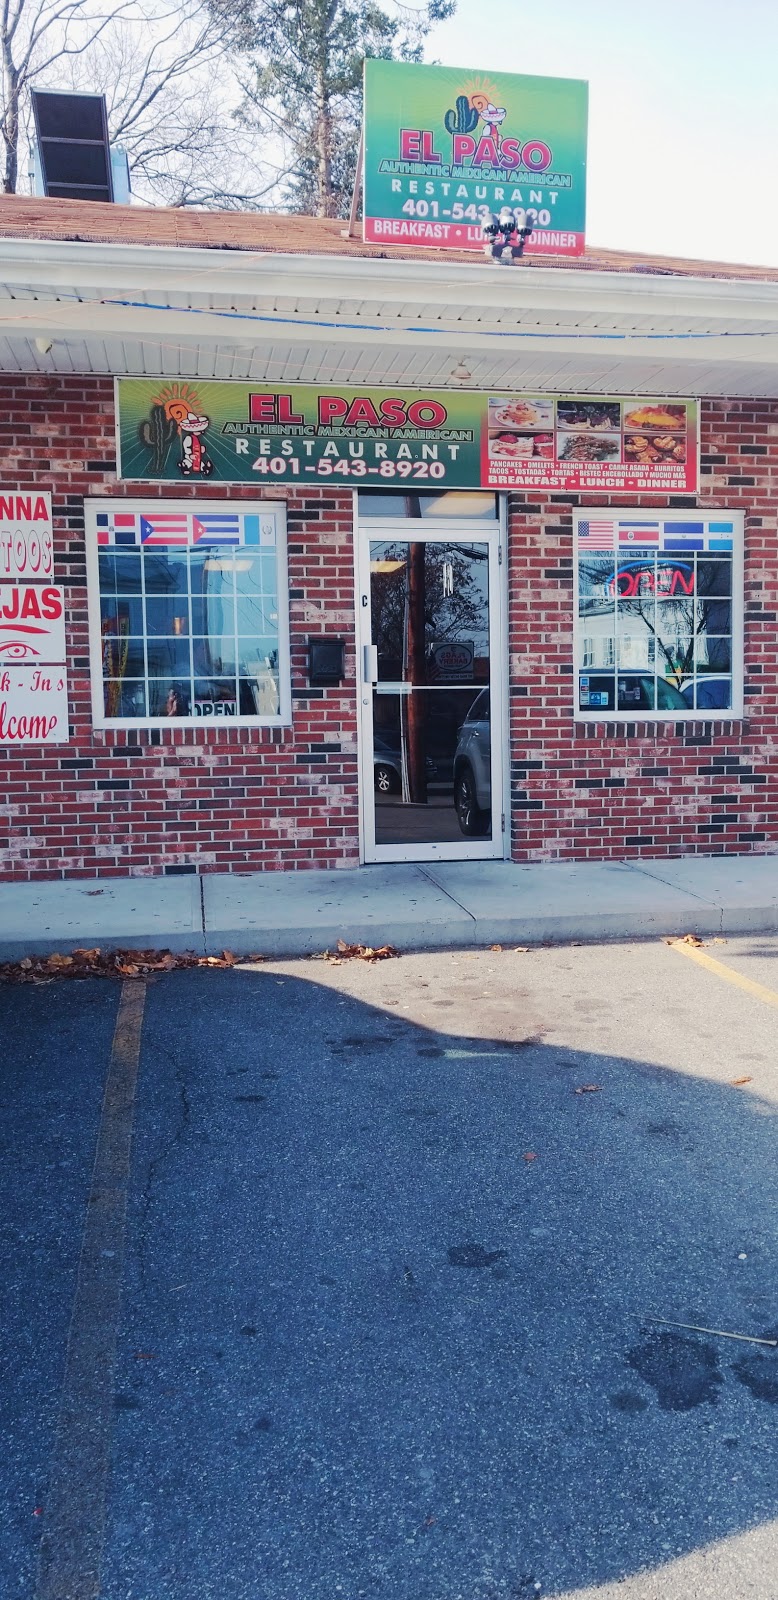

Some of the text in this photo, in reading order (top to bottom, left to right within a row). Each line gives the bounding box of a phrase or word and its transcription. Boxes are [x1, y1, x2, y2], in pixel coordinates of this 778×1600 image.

[400, 129, 552, 172] EL PASO
[380, 160, 571, 187] AUTHENTIC MEXICAN AMERICAN
[391, 178, 559, 204] RESTAURANT
[374, 219, 450, 238] BREAKFAST
[528, 231, 577, 247] DINNER
[249, 393, 447, 428] EL PASO
[223, 423, 472, 442] AUTHENTIC MEXICAN AMERICAN
[236, 438, 461, 460] RESTAURANT
[252, 458, 446, 478] 401-543-8920
[488, 475, 686, 488] BREAKFAST LUNCH DINNER
[609, 570, 696, 596] OPEN
[362, 595, 367, 607] C
